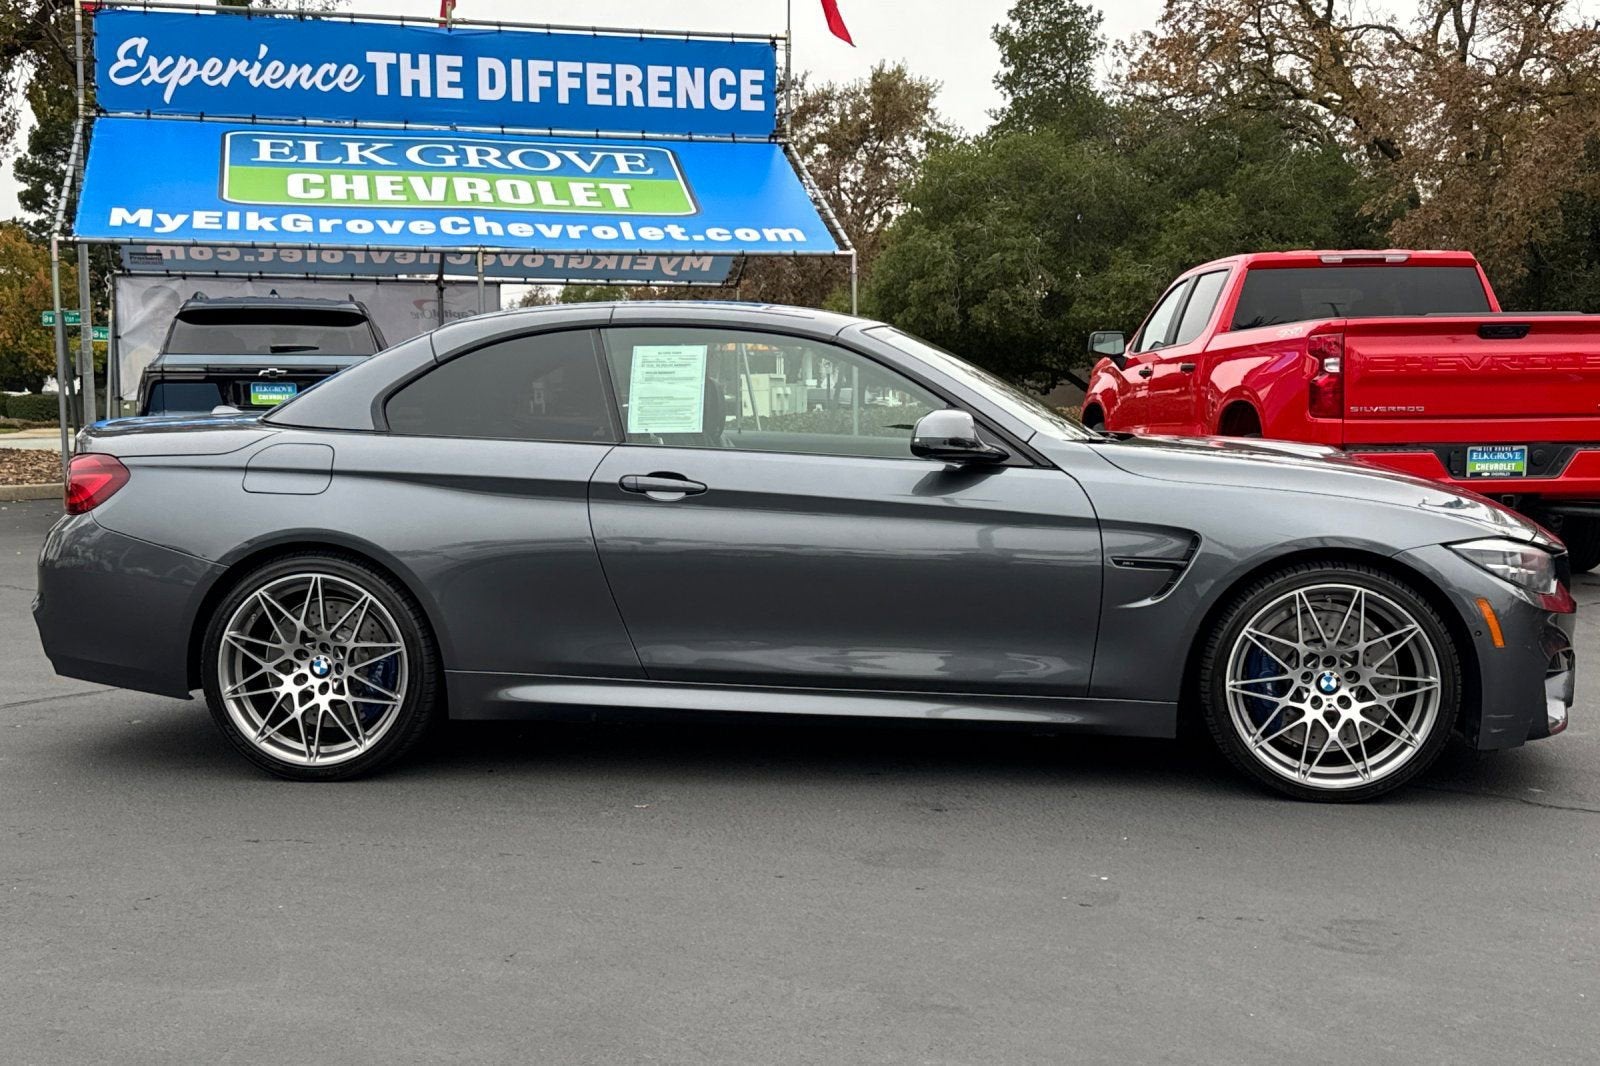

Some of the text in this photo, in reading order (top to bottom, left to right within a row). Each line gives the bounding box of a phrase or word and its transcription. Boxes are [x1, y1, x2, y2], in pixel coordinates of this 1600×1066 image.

[109, 37, 766, 111] Experience THE DIFFERENCE
[251, 138, 655, 175] ELK GROVE
[287, 173, 632, 209] CHEVROLET
[109, 207, 807, 242] MyElkGroveChevrolet.com
[1472, 451, 1521, 460] ELK GROVE
[1475, 462, 1516, 471] CHEVROLET
